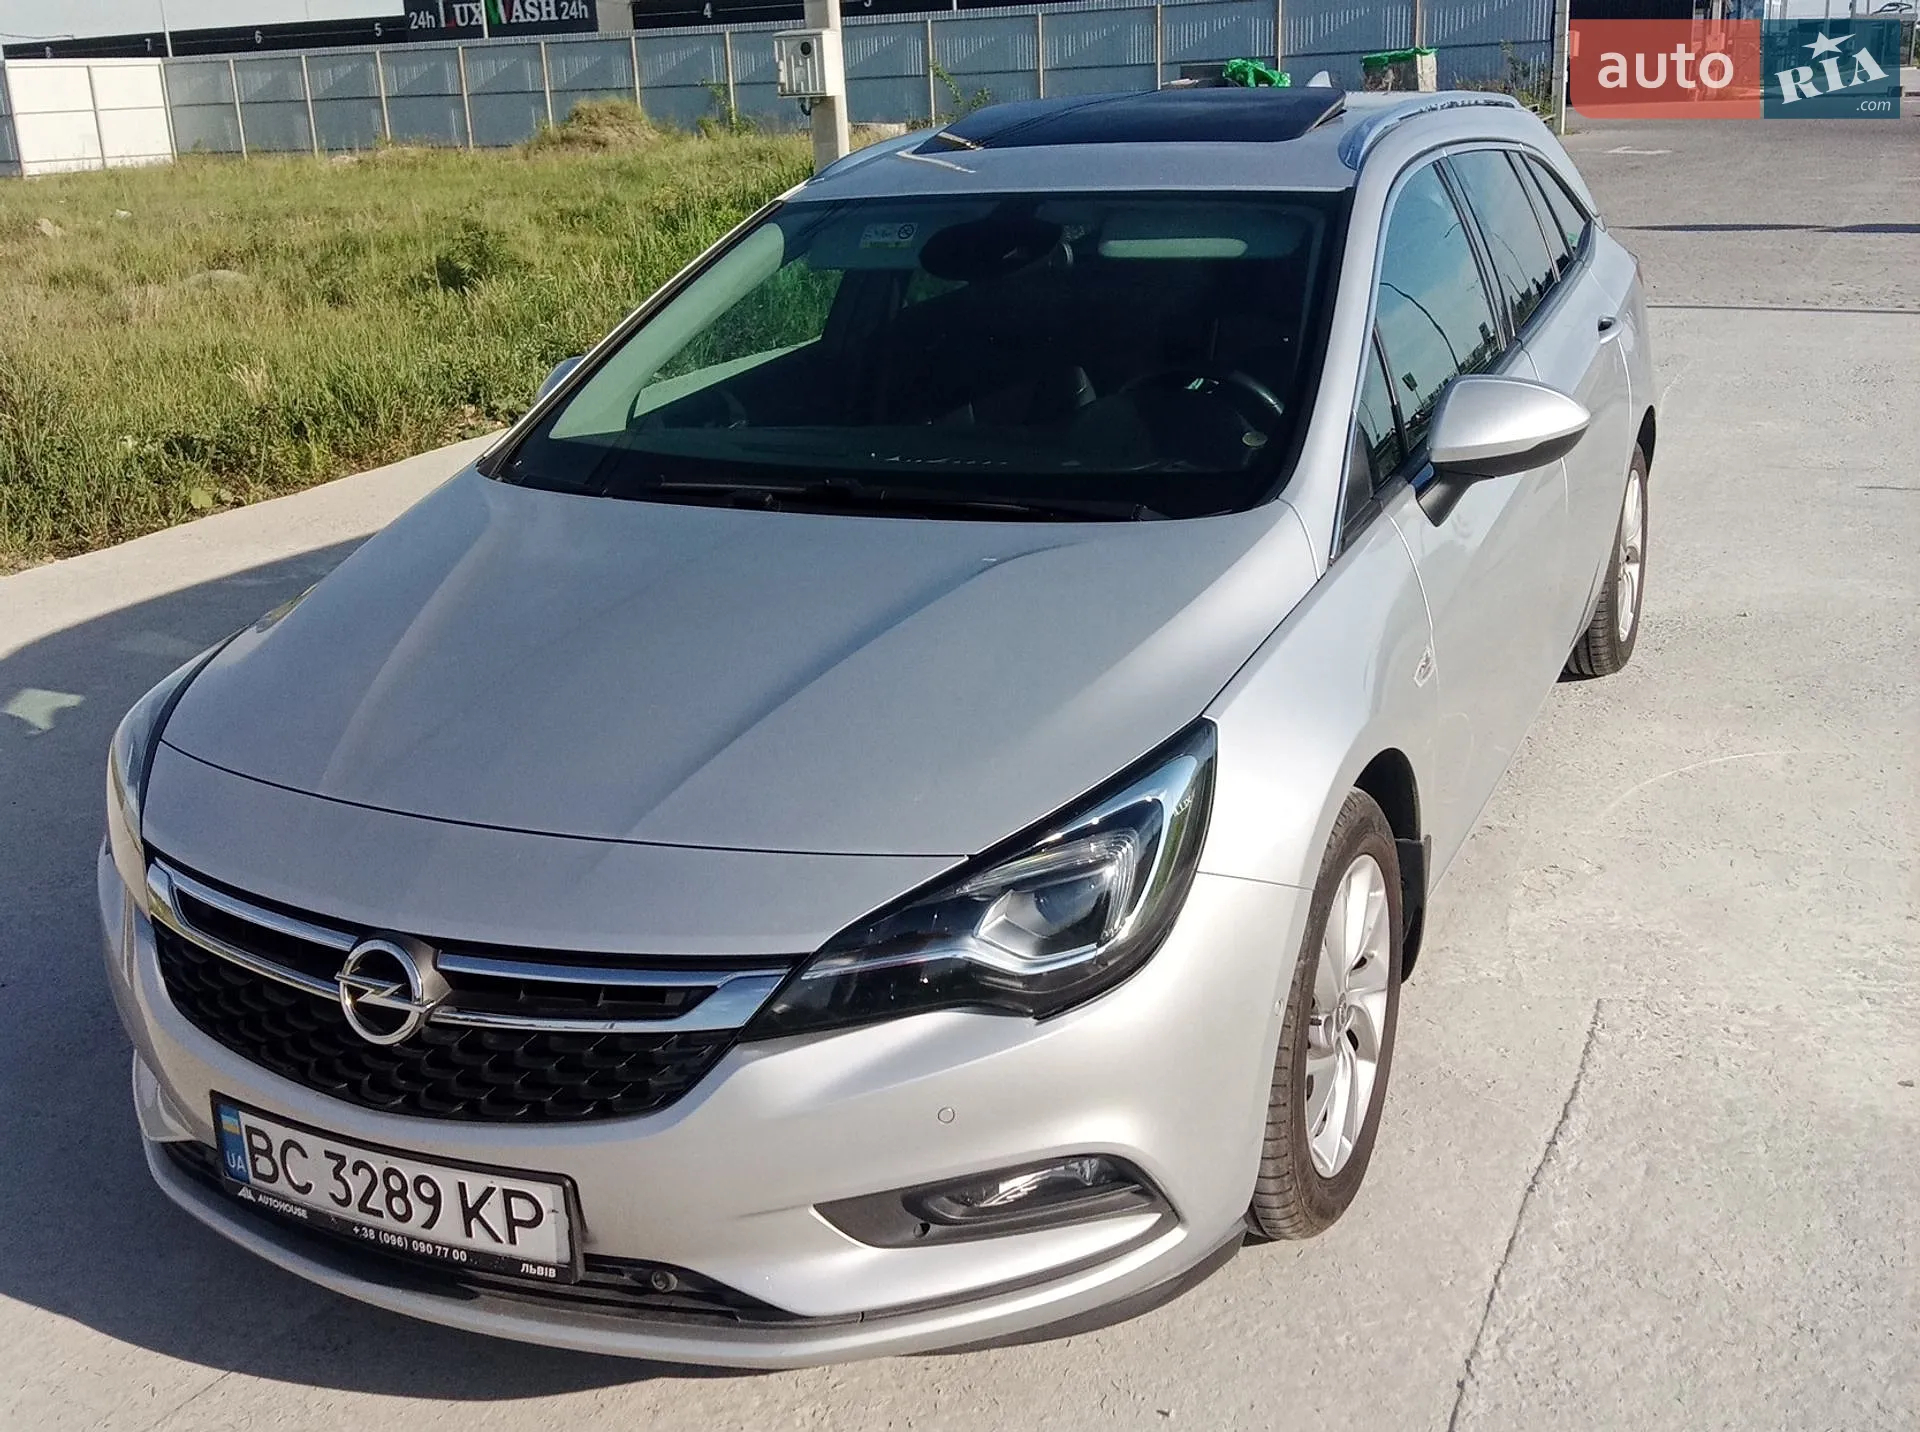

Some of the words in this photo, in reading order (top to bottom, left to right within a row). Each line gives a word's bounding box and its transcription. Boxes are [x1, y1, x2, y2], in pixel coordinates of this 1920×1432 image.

[409, 11, 436, 30] 24h
[560, 1, 589, 20] 24h
[702, 2, 712, 19] 4
[254, 30, 263, 44] 6
[374, 22, 382, 37] 5
[226, 1151, 247, 1173] UA
[244, 1124, 313, 1195] BC
[324, 1149, 442, 1231] 3289
[458, 1180, 544, 1246] KP
[257, 1194, 308, 1219] AUTOHOUSE
[379, 1229, 408, 1250] (096)
[412, 1240, 433, 1255] 090
[435, 1244, 449, 1259] 77
[452, 1248, 467, 1262] 00
